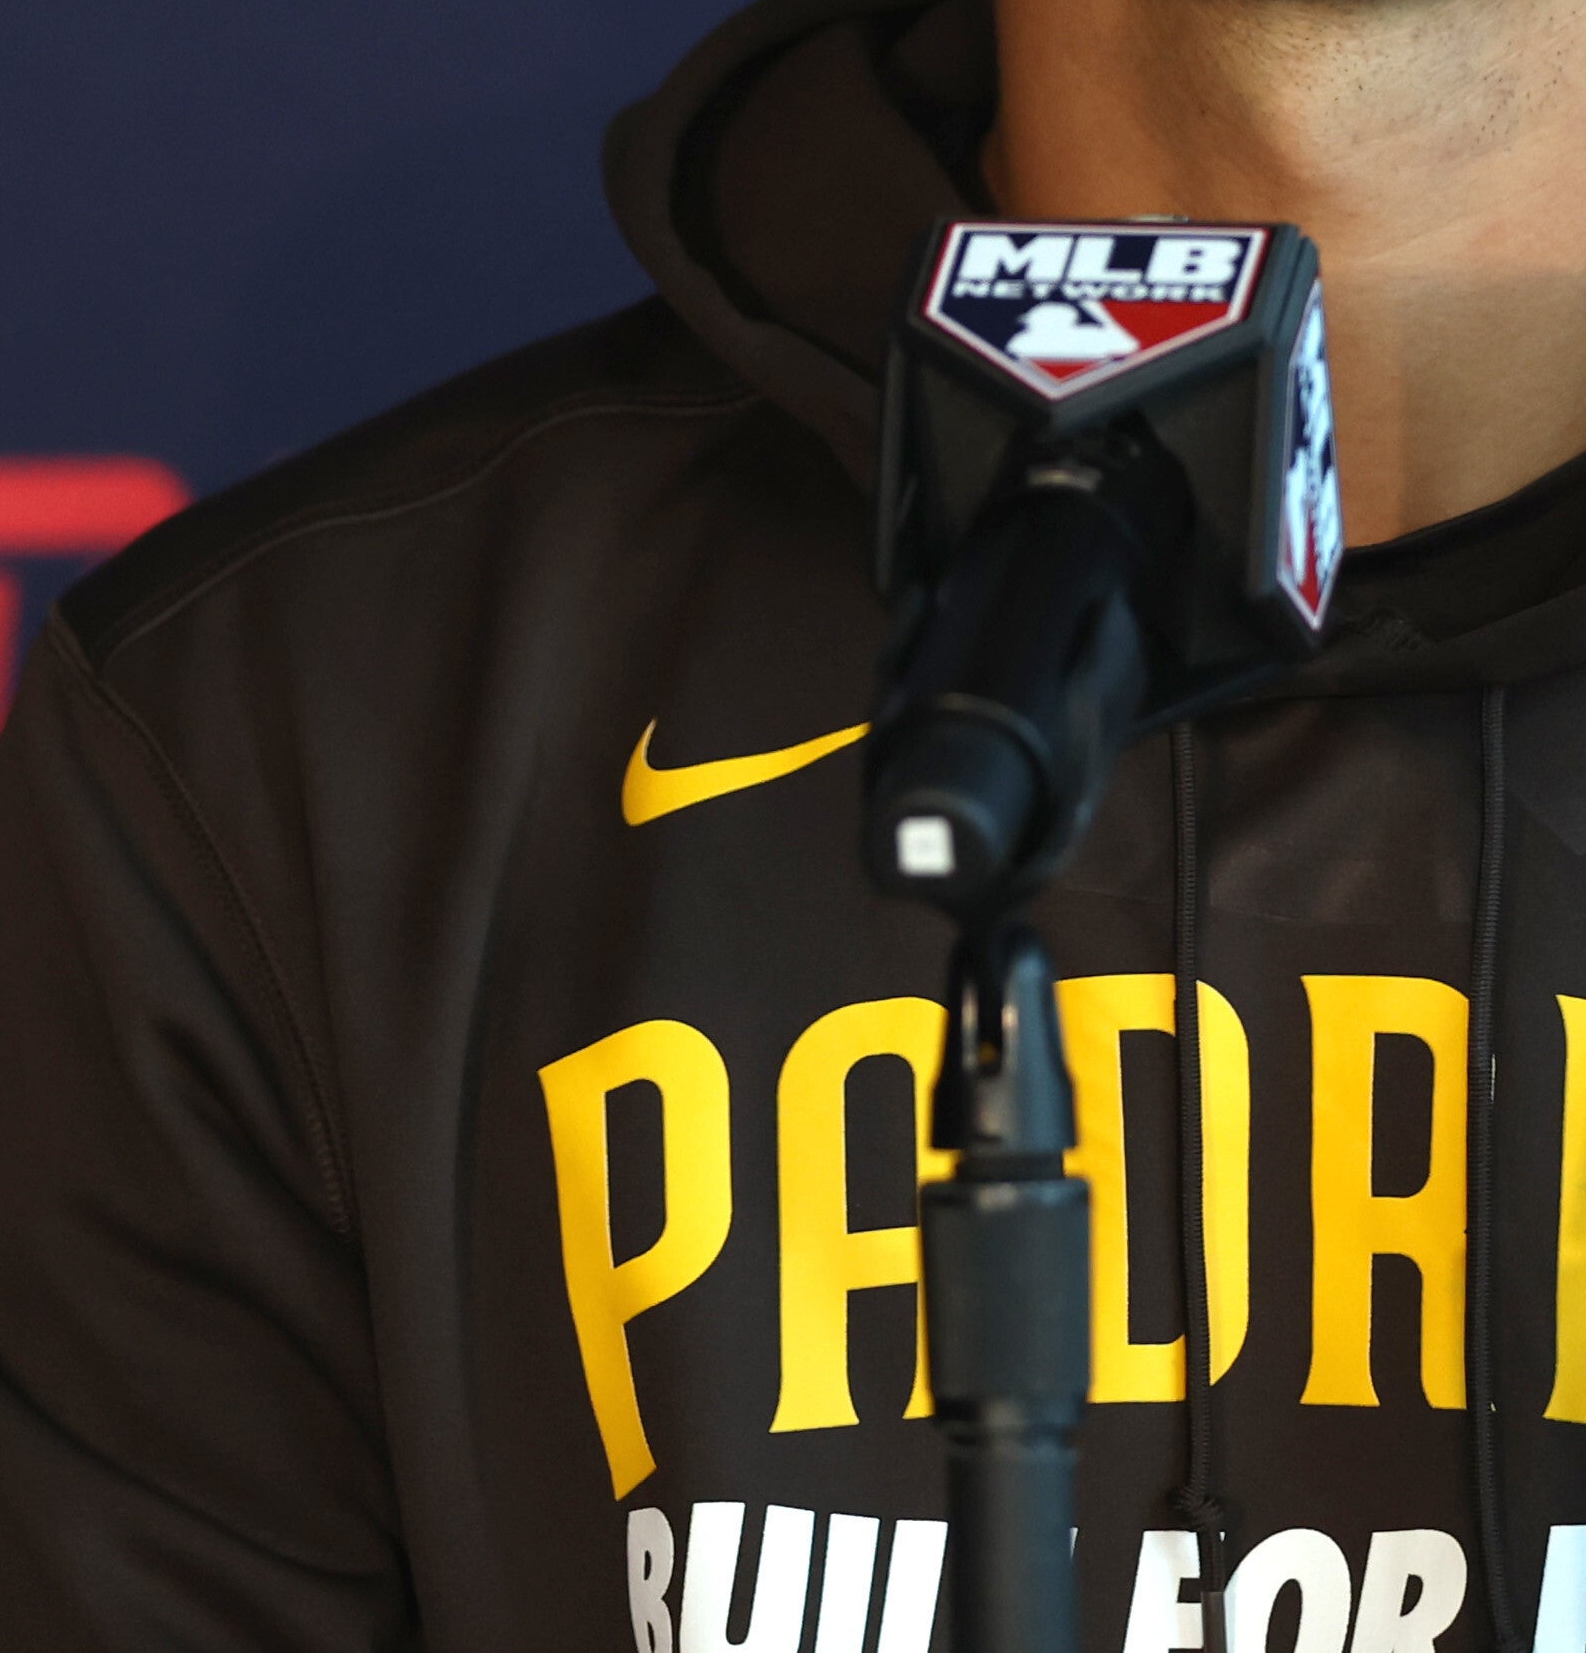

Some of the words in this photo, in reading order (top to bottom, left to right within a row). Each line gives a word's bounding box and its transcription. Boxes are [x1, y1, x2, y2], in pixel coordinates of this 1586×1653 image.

[957, 233, 1242, 284] MLB
[951, 278, 1228, 303] NETWORK
[627, 1500, 1078, 1653] BUIL
